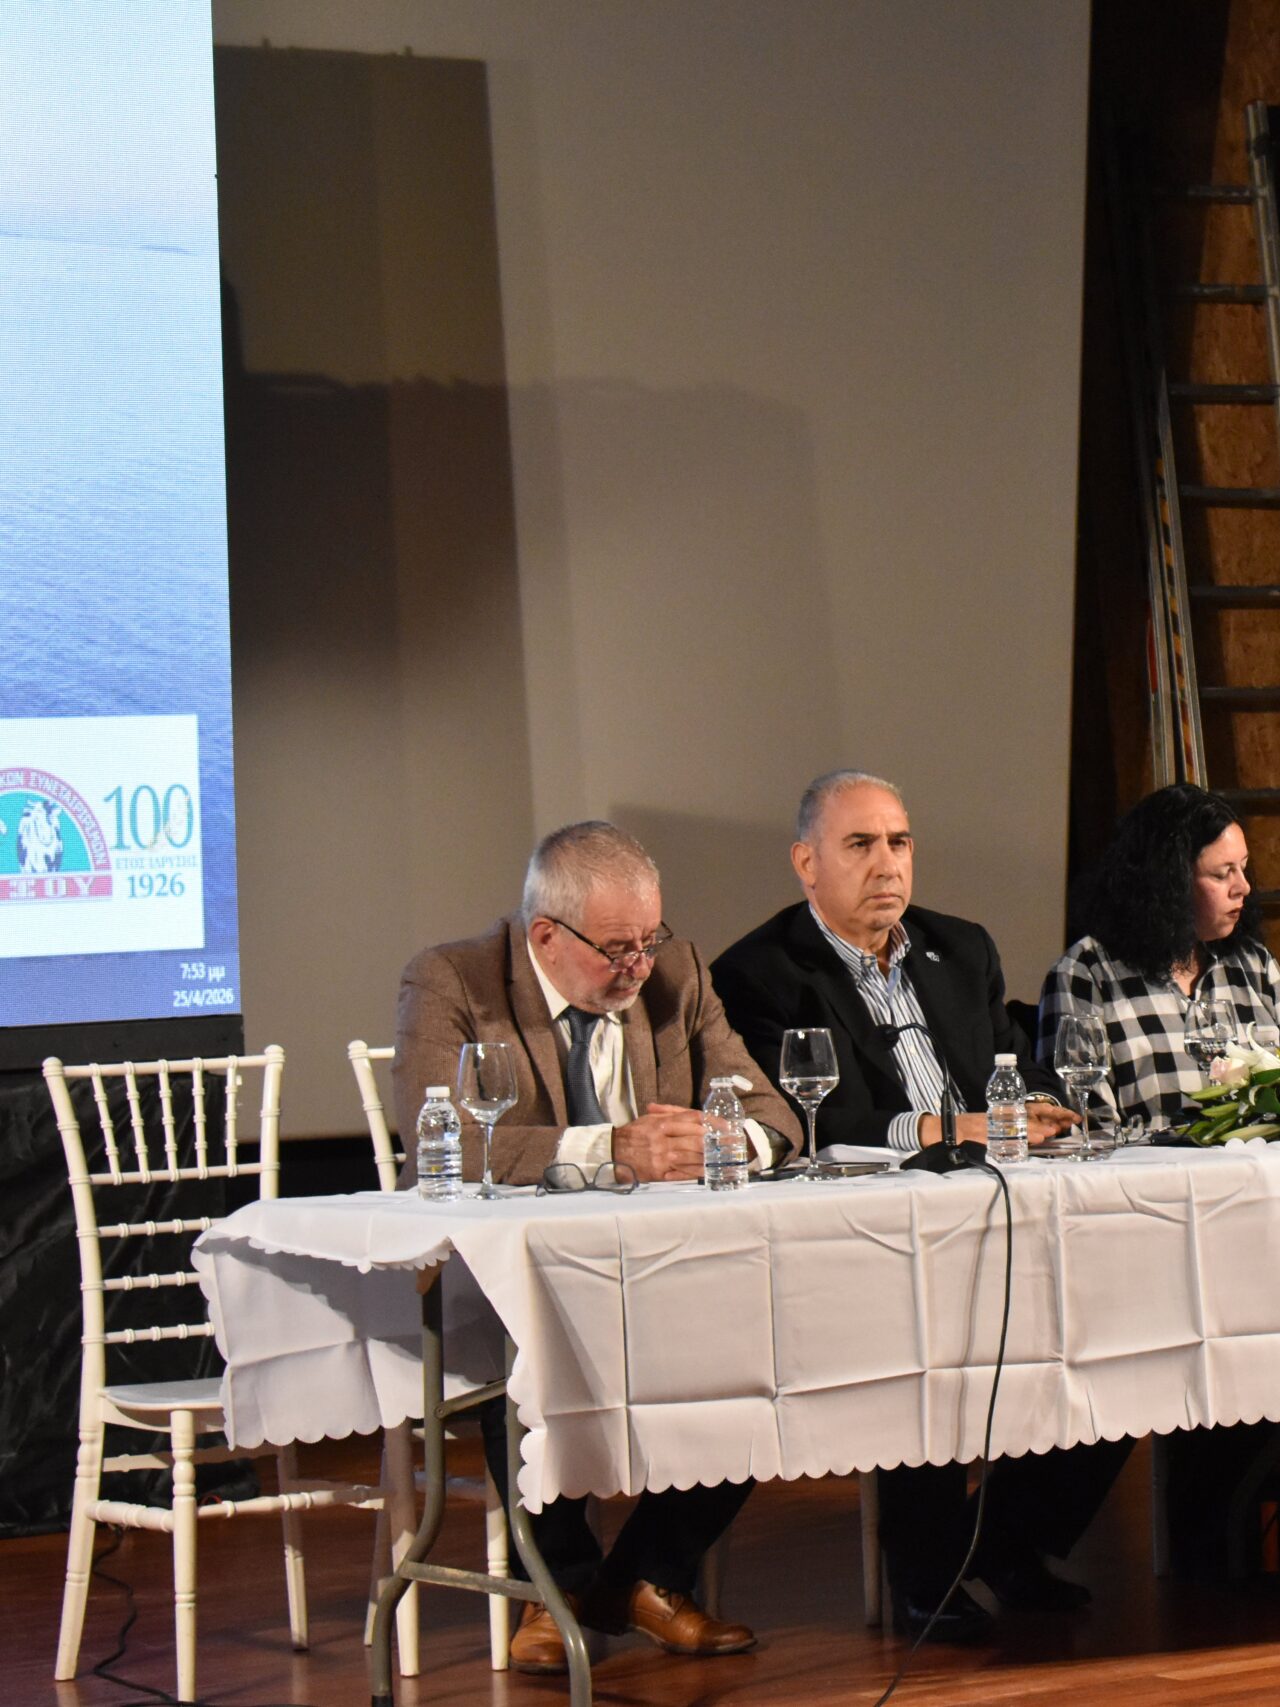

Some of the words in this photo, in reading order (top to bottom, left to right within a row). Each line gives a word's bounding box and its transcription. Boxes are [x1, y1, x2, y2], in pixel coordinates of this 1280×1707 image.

[104, 784, 194, 850] 100
[127, 872, 185, 898] 1926
[180, 962, 206, 980] 7:53
[173, 988, 235, 1008] 25/4/2026
